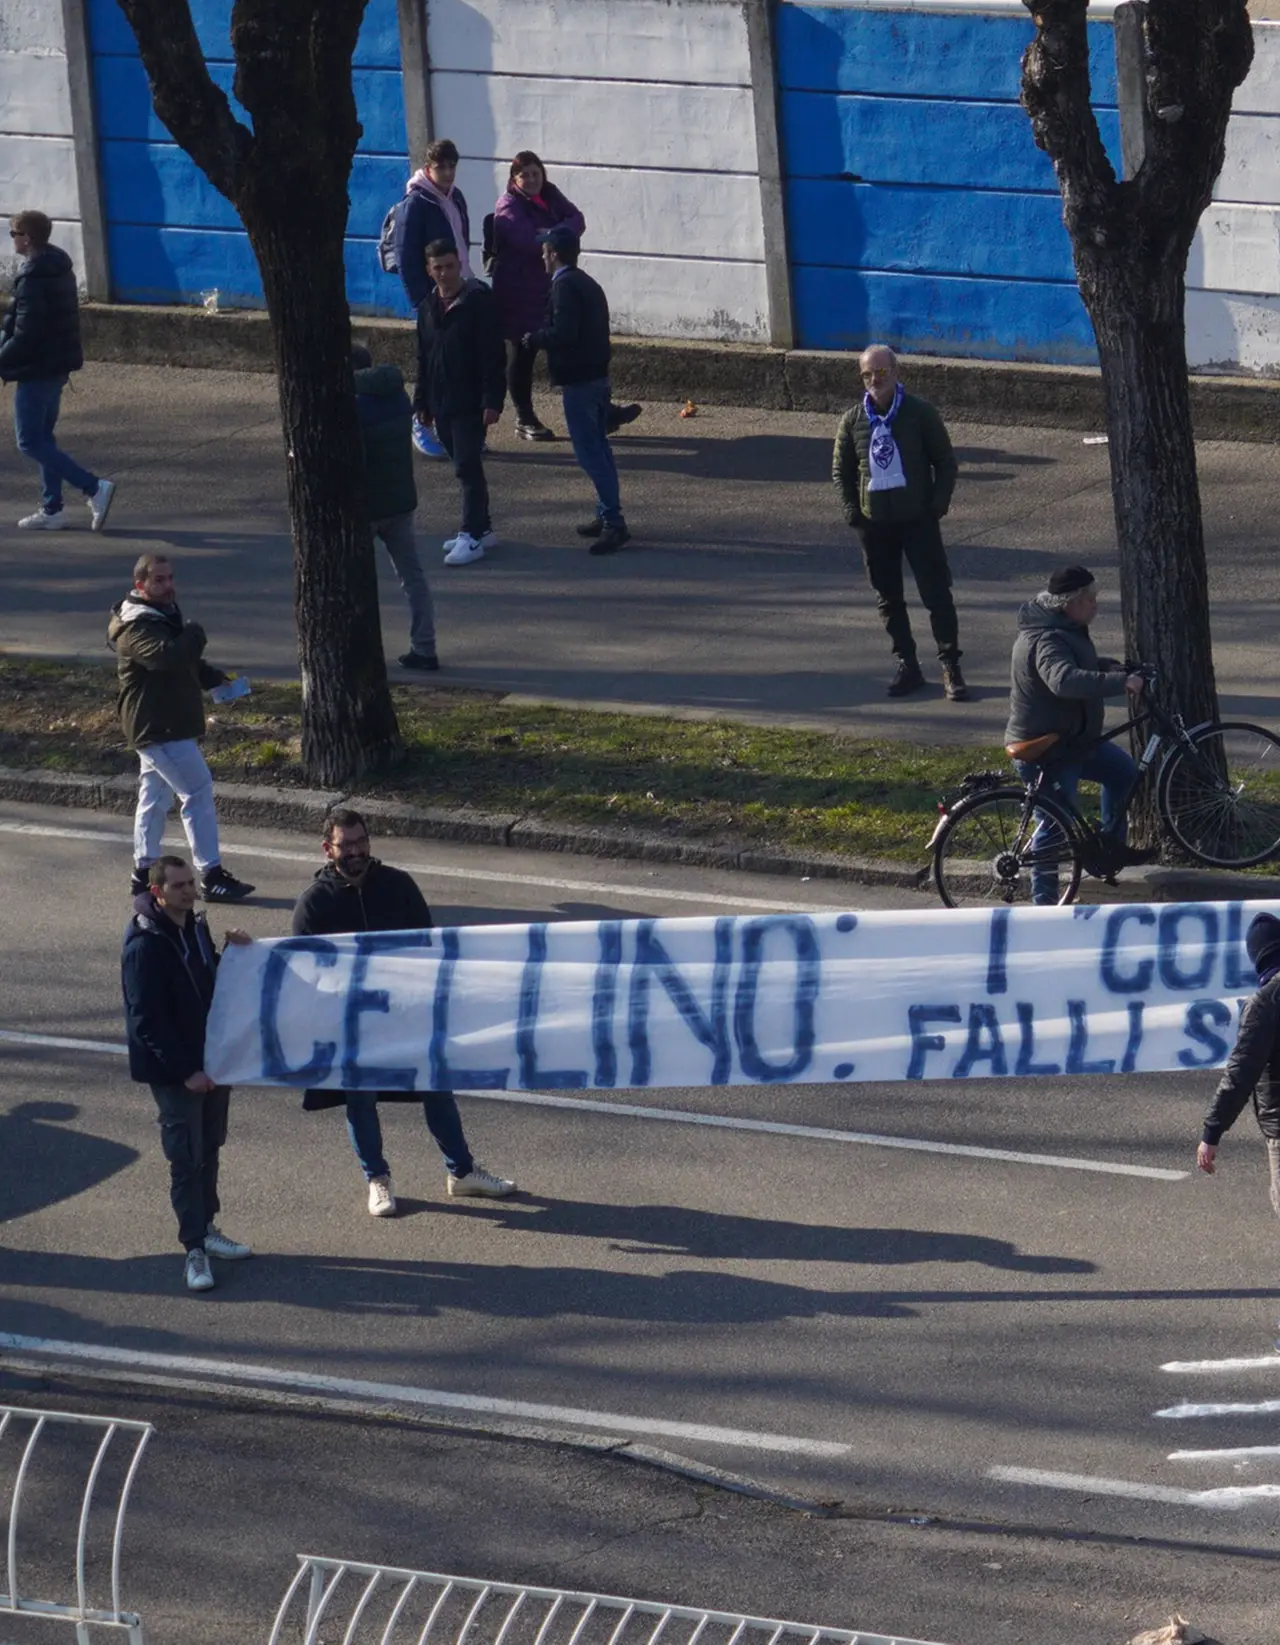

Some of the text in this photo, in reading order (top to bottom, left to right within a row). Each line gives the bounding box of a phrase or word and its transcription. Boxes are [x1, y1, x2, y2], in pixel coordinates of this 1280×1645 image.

[261, 912, 859, 1090] CELLINO:
[985, 907, 1012, 995] I
[904, 1001, 1144, 1081] FALLI
